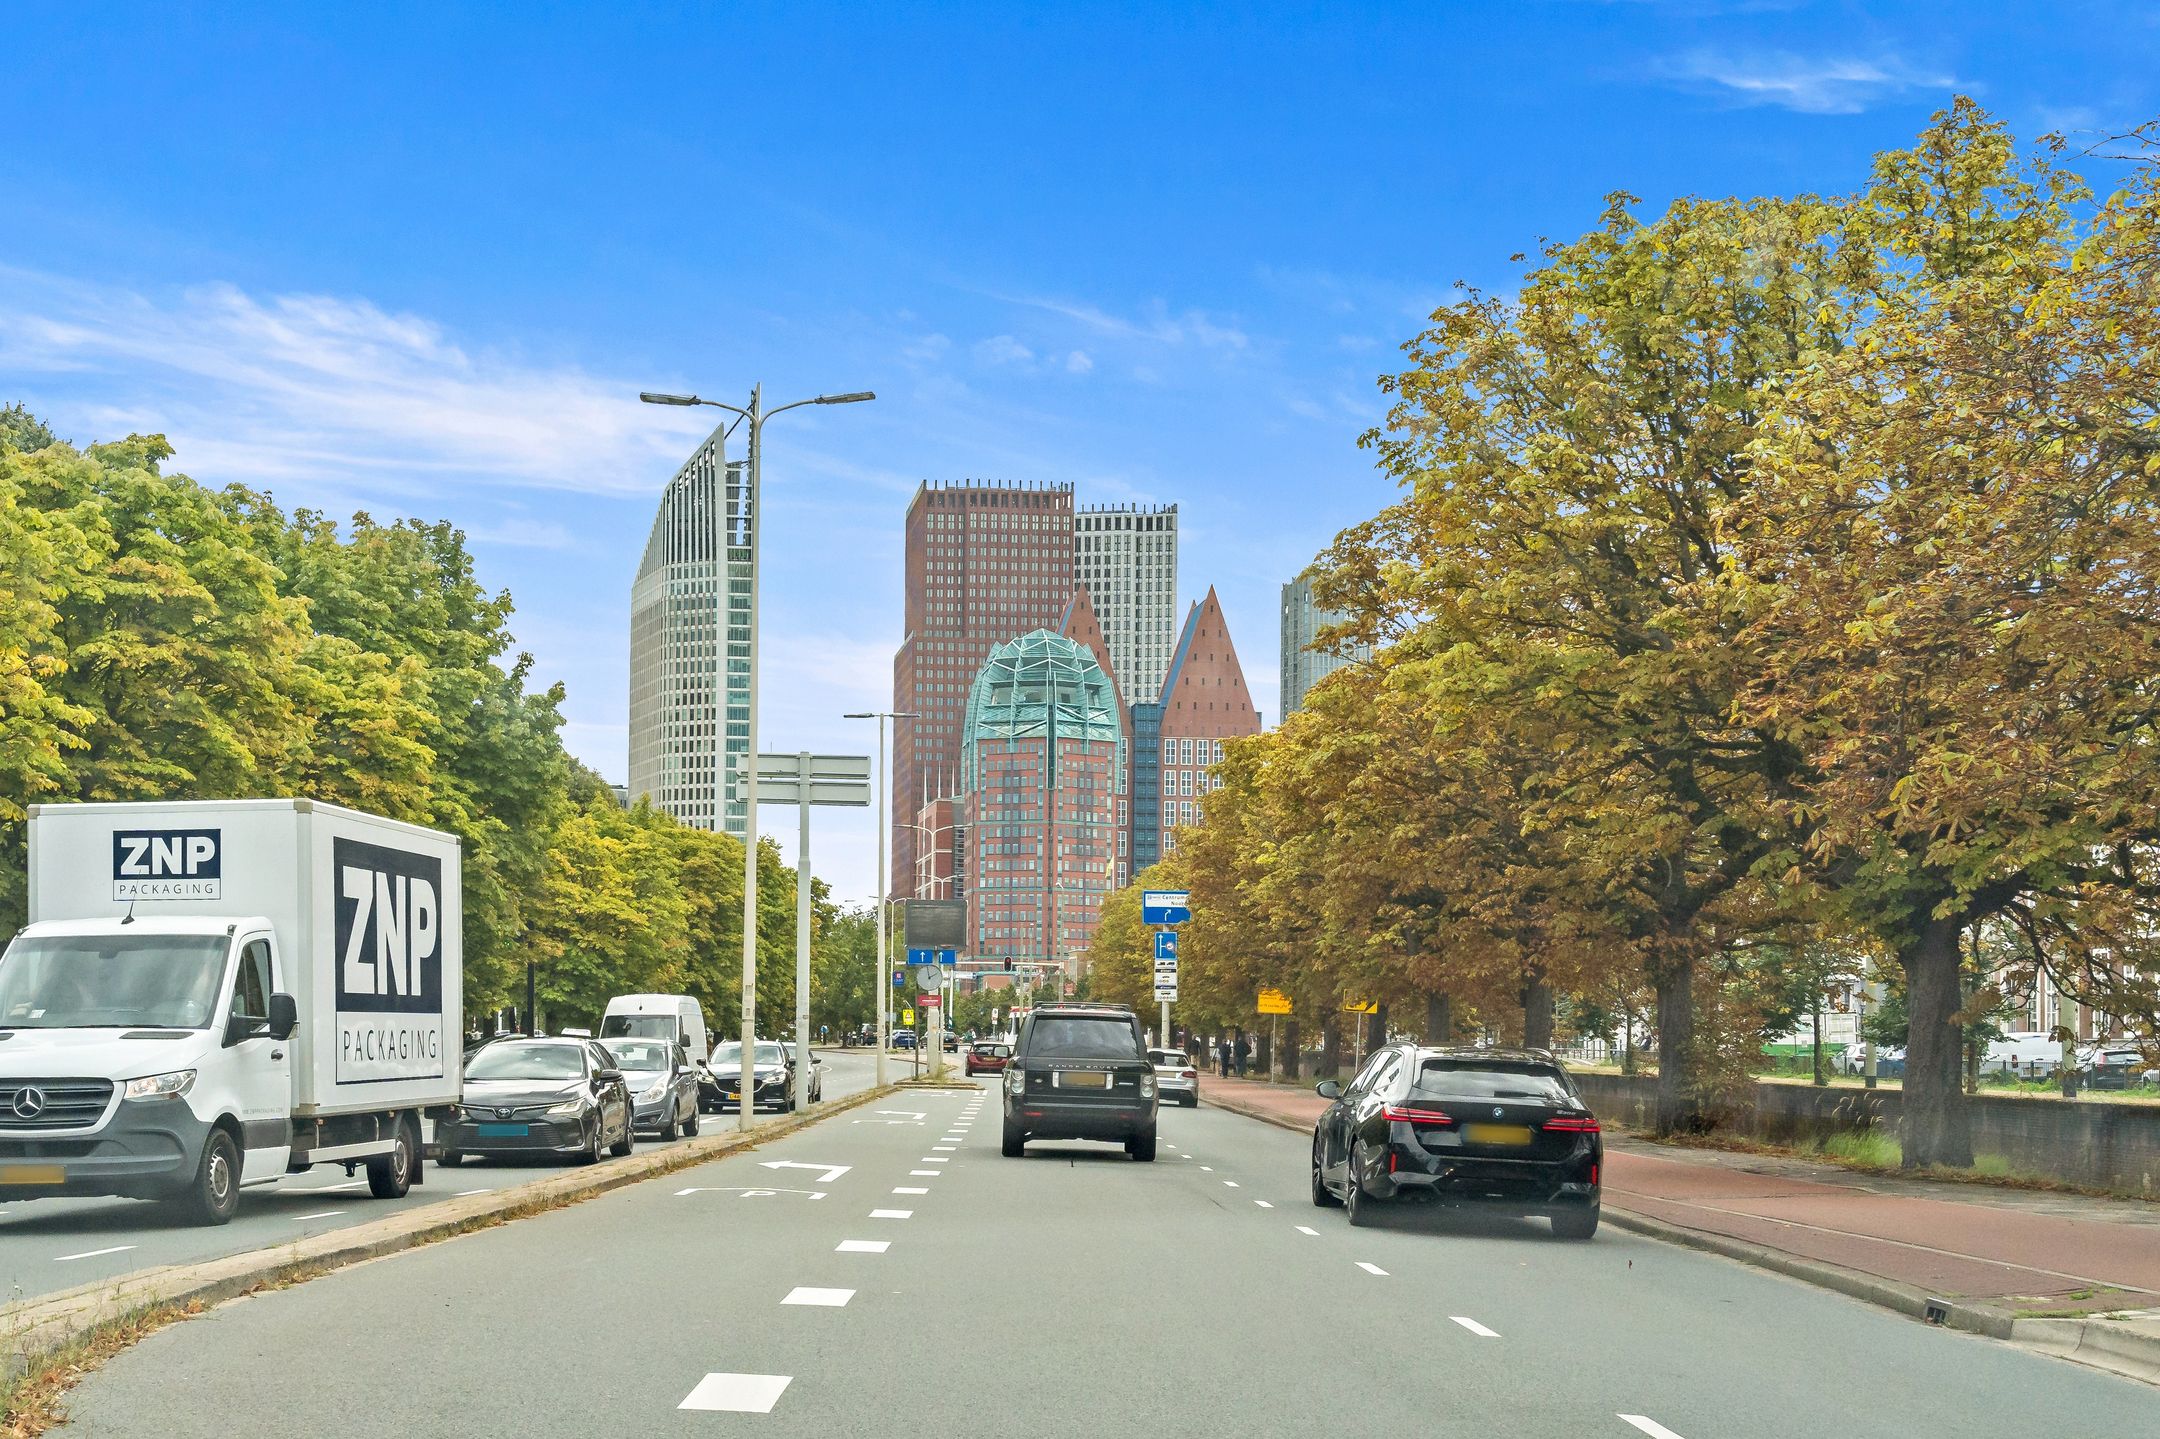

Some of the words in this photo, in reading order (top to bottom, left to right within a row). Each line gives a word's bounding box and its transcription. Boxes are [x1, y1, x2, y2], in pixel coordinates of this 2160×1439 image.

[120, 836, 216, 875] ZNP
[119, 883, 213, 894] PACKAGING
[342, 865, 437, 996] ZNP
[343, 1029, 437, 1062] PACKAGING
